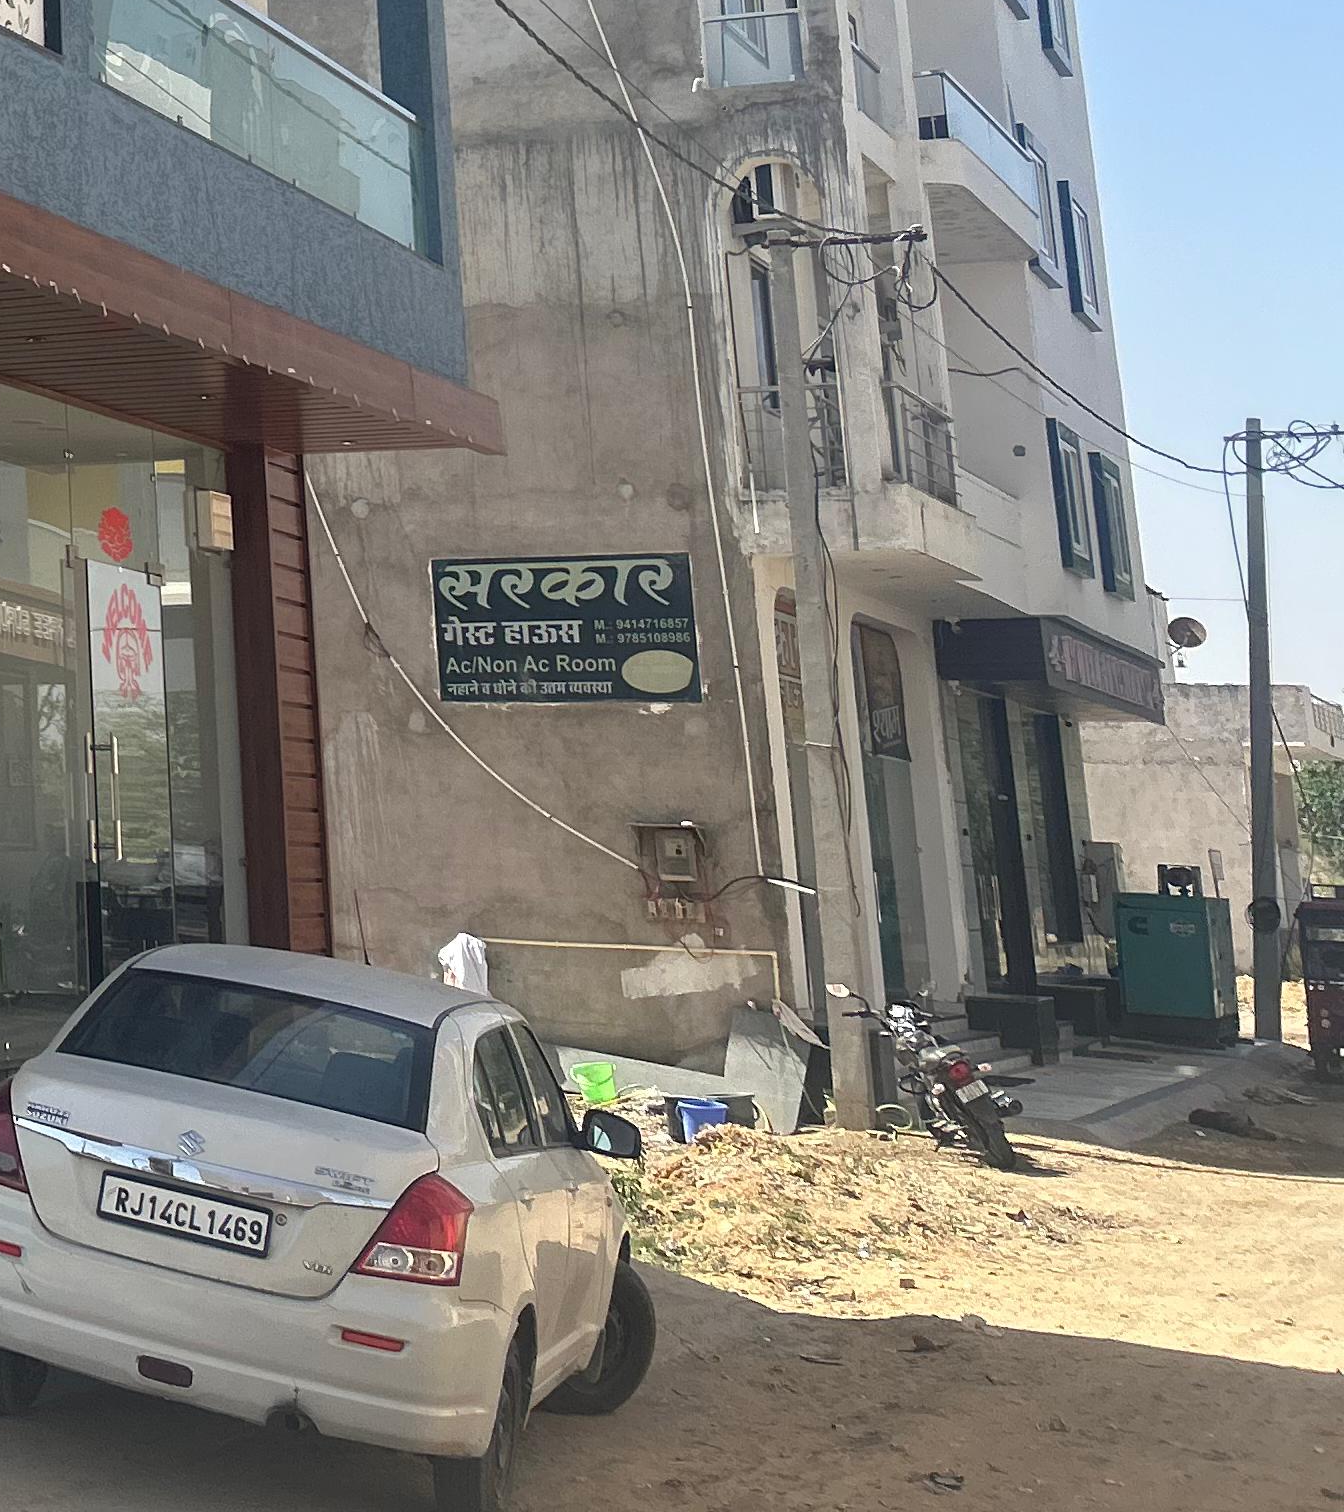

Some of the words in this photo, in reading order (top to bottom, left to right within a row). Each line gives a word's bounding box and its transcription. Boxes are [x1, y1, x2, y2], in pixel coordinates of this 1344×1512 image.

[439, 558, 674, 610] सरकार
[441, 616, 497, 646] गेस्ट
[501, 619, 583, 645] हाऊस
[446, 656, 516, 675] Ac/Non
[523, 655, 549, 674] Ac
[556, 654, 616, 673] Room
